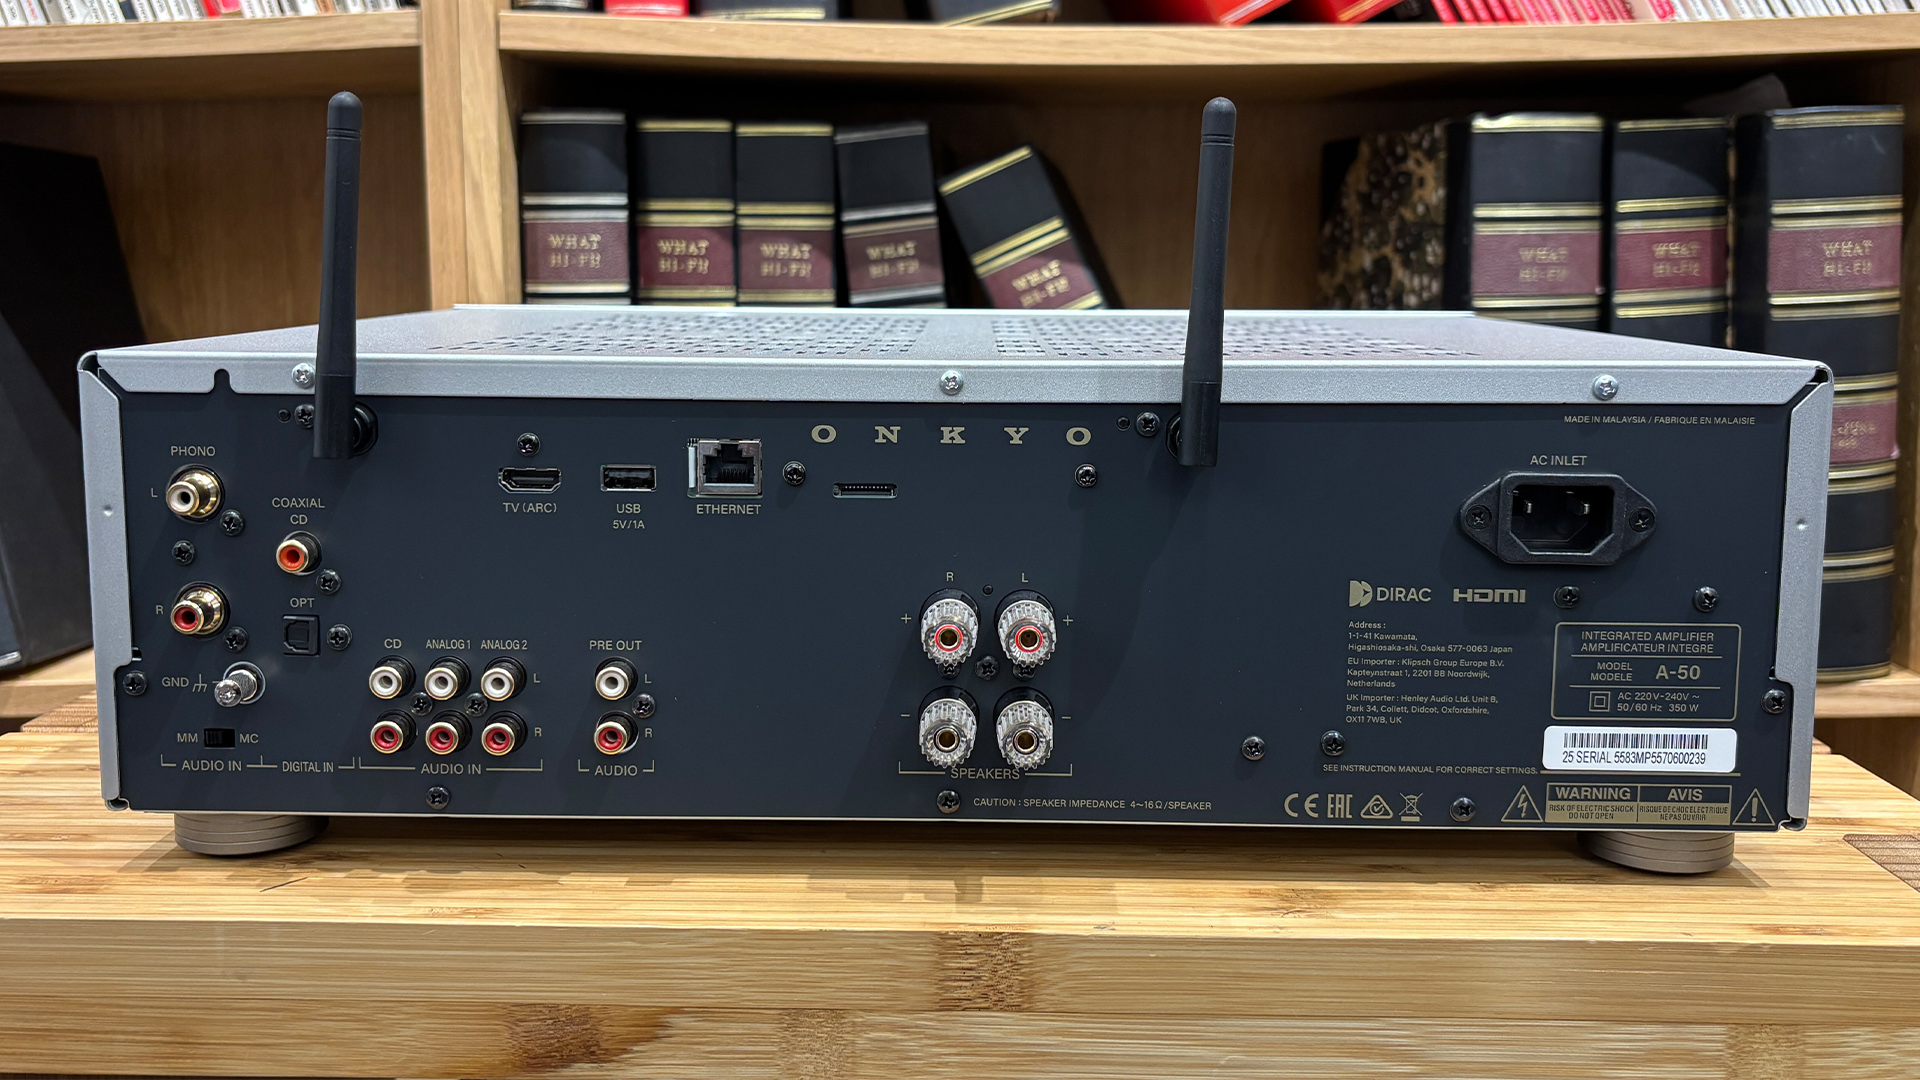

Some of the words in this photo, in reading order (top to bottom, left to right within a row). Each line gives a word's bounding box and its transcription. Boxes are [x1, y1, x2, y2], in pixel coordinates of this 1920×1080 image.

[1564, 415, 1590, 424] MADE
[1591, 415, 1600, 424] IN
[1602, 415, 1646, 425] MALAYSIA
[1654, 416, 1698, 426] FABRIQUE
[1700, 417, 1711, 425] EN
[1714, 417, 1755, 426] MALAISIE
[811, 424, 1092, 446] ONKYO
[170, 446, 216, 457] PHONO
[1530, 455, 1548, 466] AC
[1551, 455, 1588, 466] INLET
[151, 487, 158, 498] L
[272, 497, 325, 509] COAXIAL
[503, 502, 520, 513] TV
[522, 502, 557, 514] (ARC)
[616, 504, 641, 515] USB
[696, 504, 762, 516] ETHERNET
[290, 514, 308, 526] CD
[612, 519, 646, 530] 5V/1A
[946, 571, 955, 583] R
[1021, 573, 1029, 584] L
[1376, 587, 1432, 603] DIRAC
[1453, 588, 1527, 604] HDMI
[290, 598, 315, 609] OPT
[155, 605, 164, 616] R
[1348, 621, 1381, 629] Address
[1348, 632, 1372, 640] 1-1-41
[1374, 632, 1418, 641] Kawamata,
[1581, 631, 1651, 641] INTEGRATED
[1654, 632, 1714, 642] AMPLIFIER
[384, 639, 402, 649] CD
[425, 639, 464, 650] ANALOG
[480, 640, 520, 650] ANALOG
[521, 640, 528, 650] 2
[589, 641, 614, 651] PRE
[616, 641, 642, 651] OUT
[1348, 643, 1419, 653] Higashiosaka-shi,
[1420, 644, 1446, 653] Osaka
[1447, 645, 1488, 653] 577-0063
[1489, 645, 1513, 654] Japan
[1580, 643, 1665, 653] AMPLIFICATEUR
[1667, 644, 1714, 653] INTEGRE
[1347, 657, 1359, 665] EU
[1361, 658, 1396, 667] Importer
[1401, 658, 1431, 667] Klipsch
[1433, 659, 1458, 667] Group
[1459, 659, 1488, 668] Europe
[1597, 662, 1633, 671] MODEL
[533, 673, 540, 683] L
[1347, 668, 1402, 677] Kapteynstraat
[1412, 669, 1432, 677] 2201
[1447, 670, 1490, 679] Noordwijk,
[1590, 672, 1633, 681] MODELE
[1655, 665, 1701, 680] A-50
[161, 676, 190, 689] GND
[644, 673, 651, 684] L
[1346, 680, 1396, 688] Netherlands
[1360, 694, 1395, 703] Importer
[1400, 695, 1429, 704] Henley
[1430, 695, 1454, 703] Audio
[1454, 695, 1470, 703] Ltd.
[1617, 692, 1632, 701] AC
[1366, 705, 1379, 713] 34,
[1380, 705, 1409, 714] Collett,
[1411, 706, 1439, 714] Didcot,
[1441, 706, 1490, 715] Oxfordshire,
[1616, 703, 1648, 712] 50/60
[1650, 704, 1663, 712] Hz
[1668, 704, 1687, 713] 350
[1689, 704, 1699, 712] W
[534, 727, 542, 737] R
[645, 728, 653, 738] R
[177, 733, 198, 743] MM
[239, 733, 259, 744] MC
[1562, 751, 1574, 763] 25
[1576, 751, 1611, 763] SERIAL
[1614, 752, 1706, 765] 5583MP5570600239
[181, 760, 225, 772] AUDIO
[228, 761, 242, 771] IN
[282, 761, 321, 772] DIGITAL
[323, 762, 334, 772] IN
[421, 763, 464, 775] AUDIO
[468, 764, 482, 774] IN
[594, 765, 638, 776] AUDIO
[1323, 764, 1338, 772] SEE
[1340, 764, 1396, 773] INSTRUCTION
[1398, 765, 1434, 774] MANUAL
[1436, 766, 1452, 774] FOR
[1454, 766, 1494, 774] CORRECT
[1495, 766, 1538, 775] SETTINGS.
[950, 768, 1020, 780] SPEAKERS
[1556, 787, 1631, 800] WARNING
[1667, 788, 1703, 801] AVIS
[973, 798, 1016, 807] CAUTION
[1023, 799, 1067, 808] SPEAKER
[1068, 799, 1126, 809] IMPEDANCE
[1611, 805, 1634, 813] SHOCK
[1671, 806, 1689, 814] CHOC
